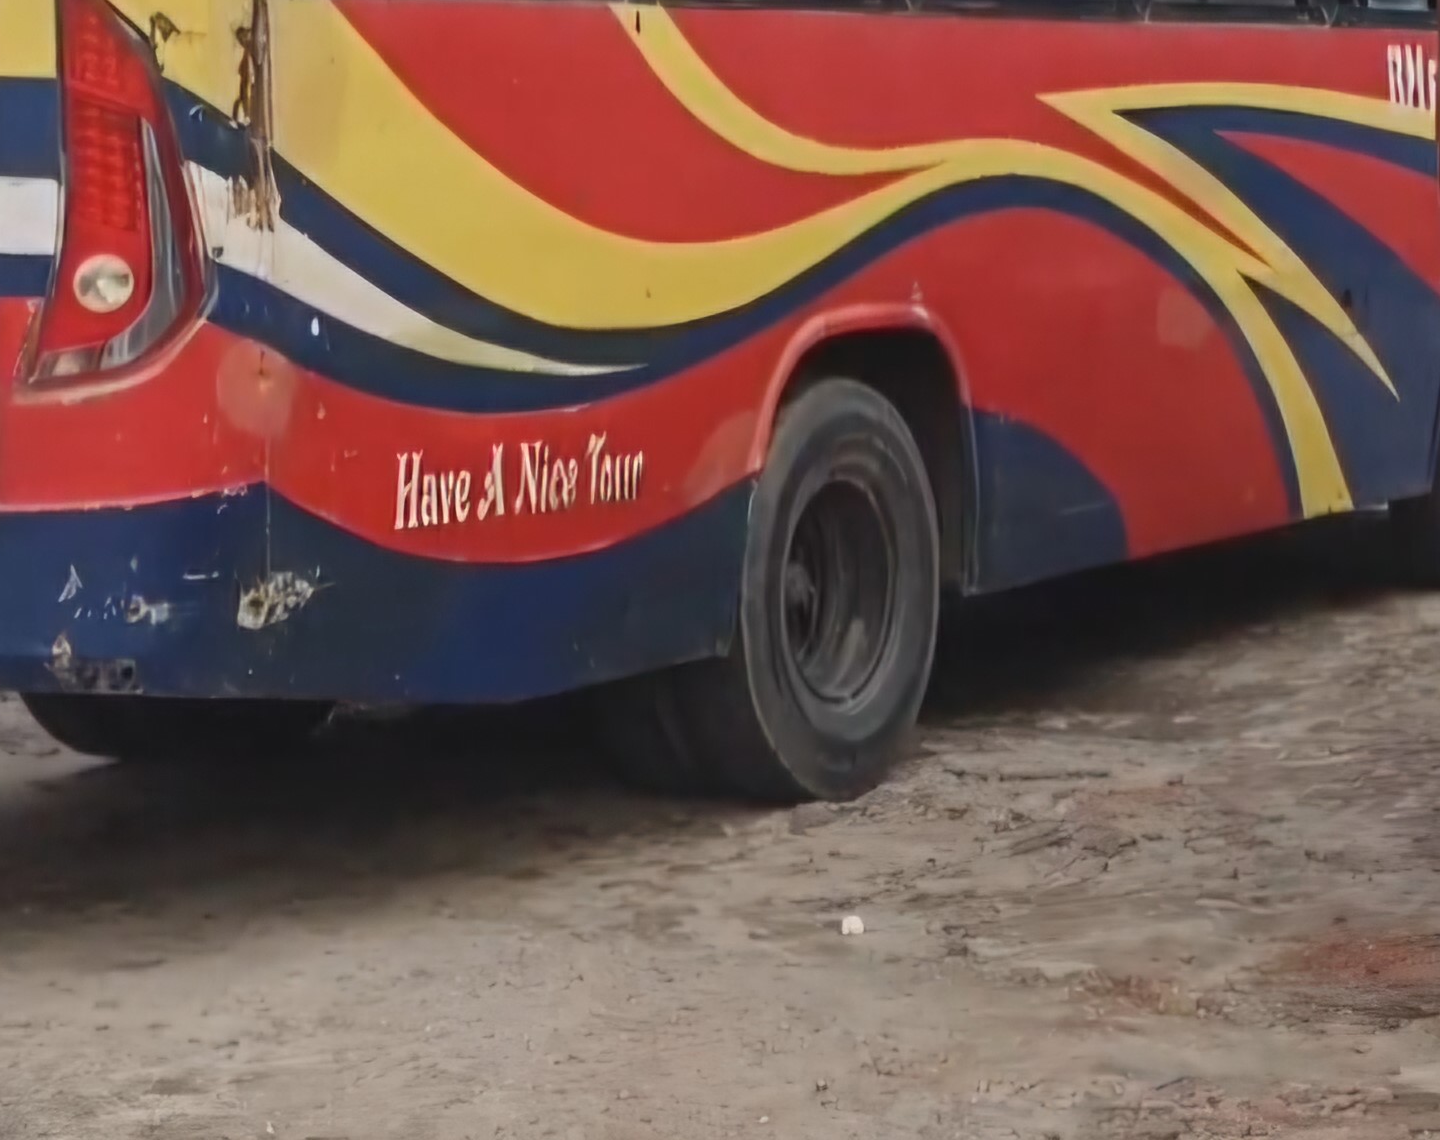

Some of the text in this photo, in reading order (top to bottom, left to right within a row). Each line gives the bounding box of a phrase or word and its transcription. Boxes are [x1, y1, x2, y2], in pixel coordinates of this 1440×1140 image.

[394, 430, 644, 530] Have A Nice Tour
